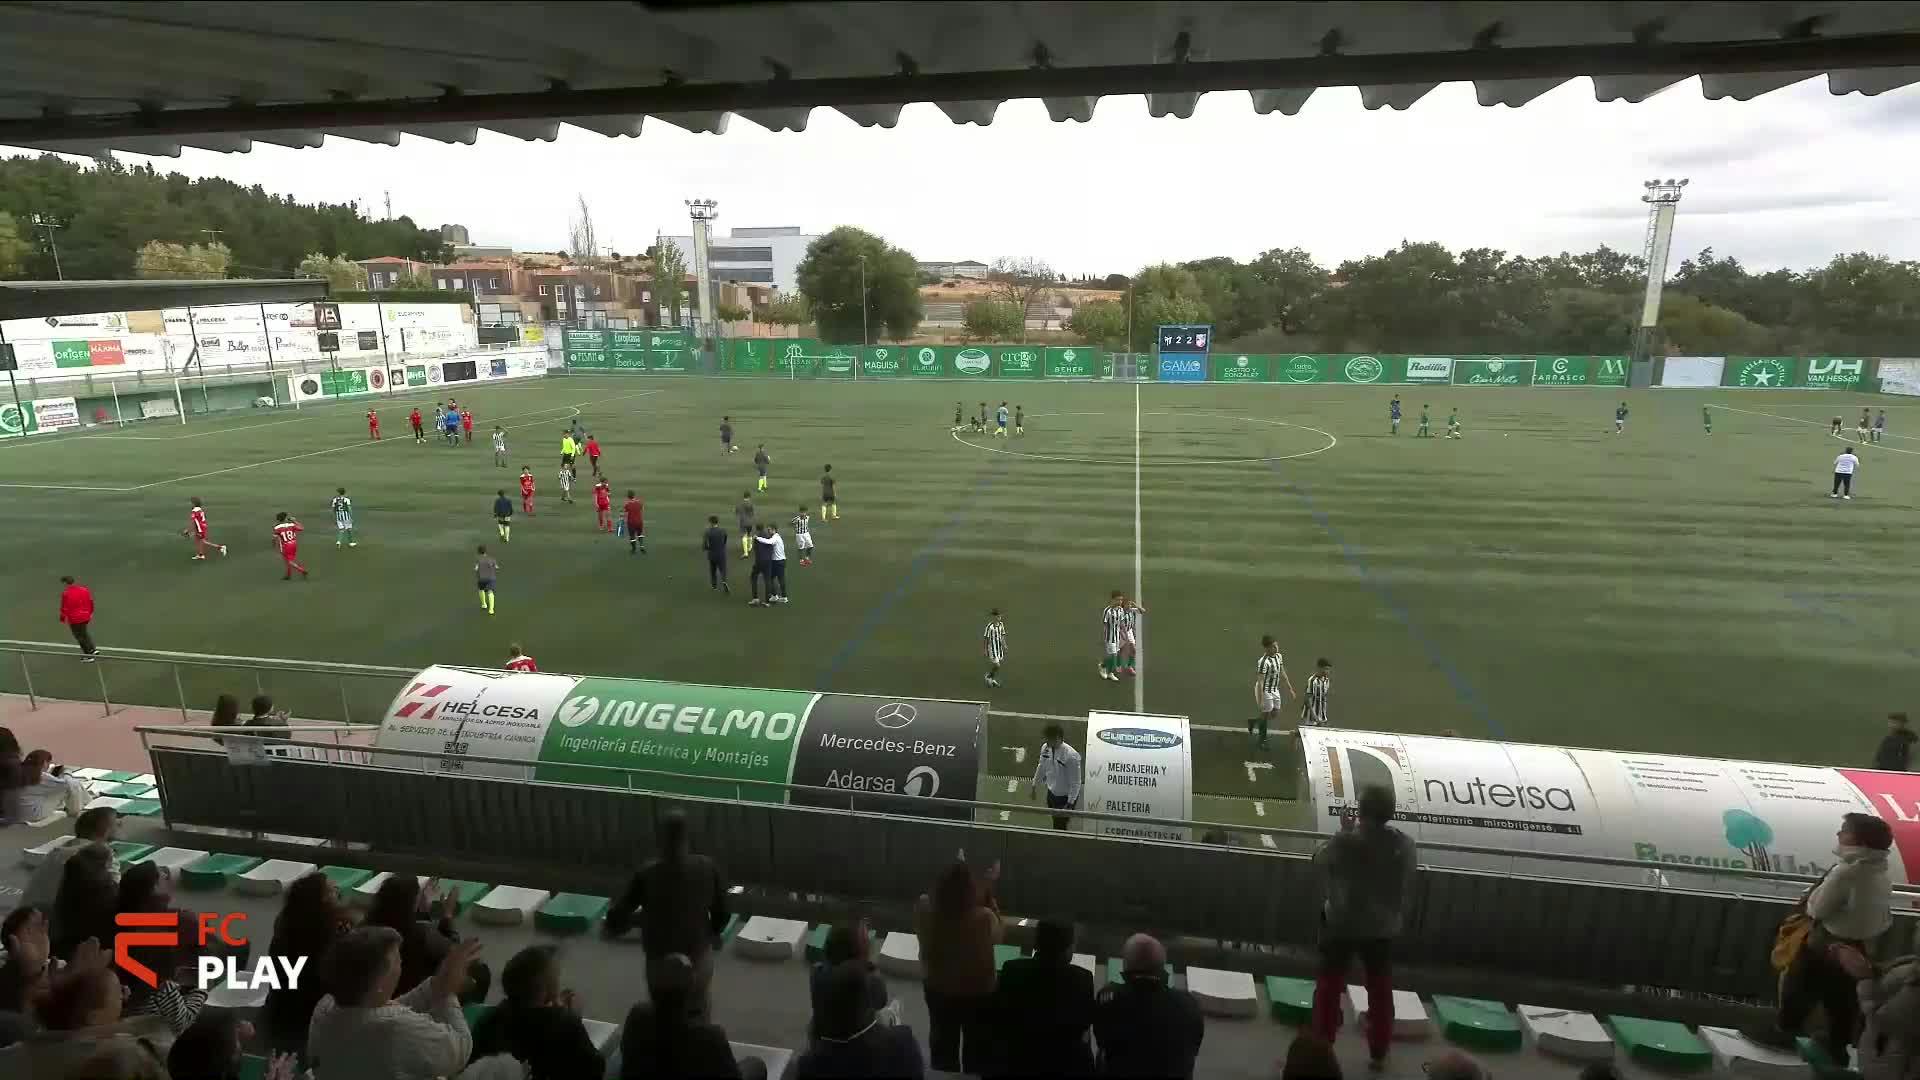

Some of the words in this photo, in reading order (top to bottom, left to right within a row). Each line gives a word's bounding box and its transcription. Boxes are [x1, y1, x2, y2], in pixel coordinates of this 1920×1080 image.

[1175, 336, 1182, 344] 2
[1186, 336, 1193, 344] 2
[864, 361, 899, 370] MAGUISA
[1161, 360, 1201, 372] GAMO
[1409, 362, 1448, 372] Rodilla
[1808, 374, 1826, 382] VAN
[1826, 375, 1860, 383] HESSEN
[441, 701, 540, 719] HELCESA
[597, 699, 797, 741] INGELMO
[400, 725, 436, 735] SERVICIO
[560, 734, 626, 753] Ingeniería
[630, 740, 689, 761] Eléctrica
[693, 750, 702, 765] y
[705, 747, 769, 769] Montajes
[820, 733, 957, 757] Mercedes-Benz
[1108, 762, 1159, 775] MENSAJERIA
[1161, 766, 1167, 776] Y
[825, 769, 896, 793] Adarsa
[1107, 774, 1157, 788] PAQUETERIA
[1423, 777, 1577, 812] nutersa
[1416, 813, 1474, 826] veterinario
